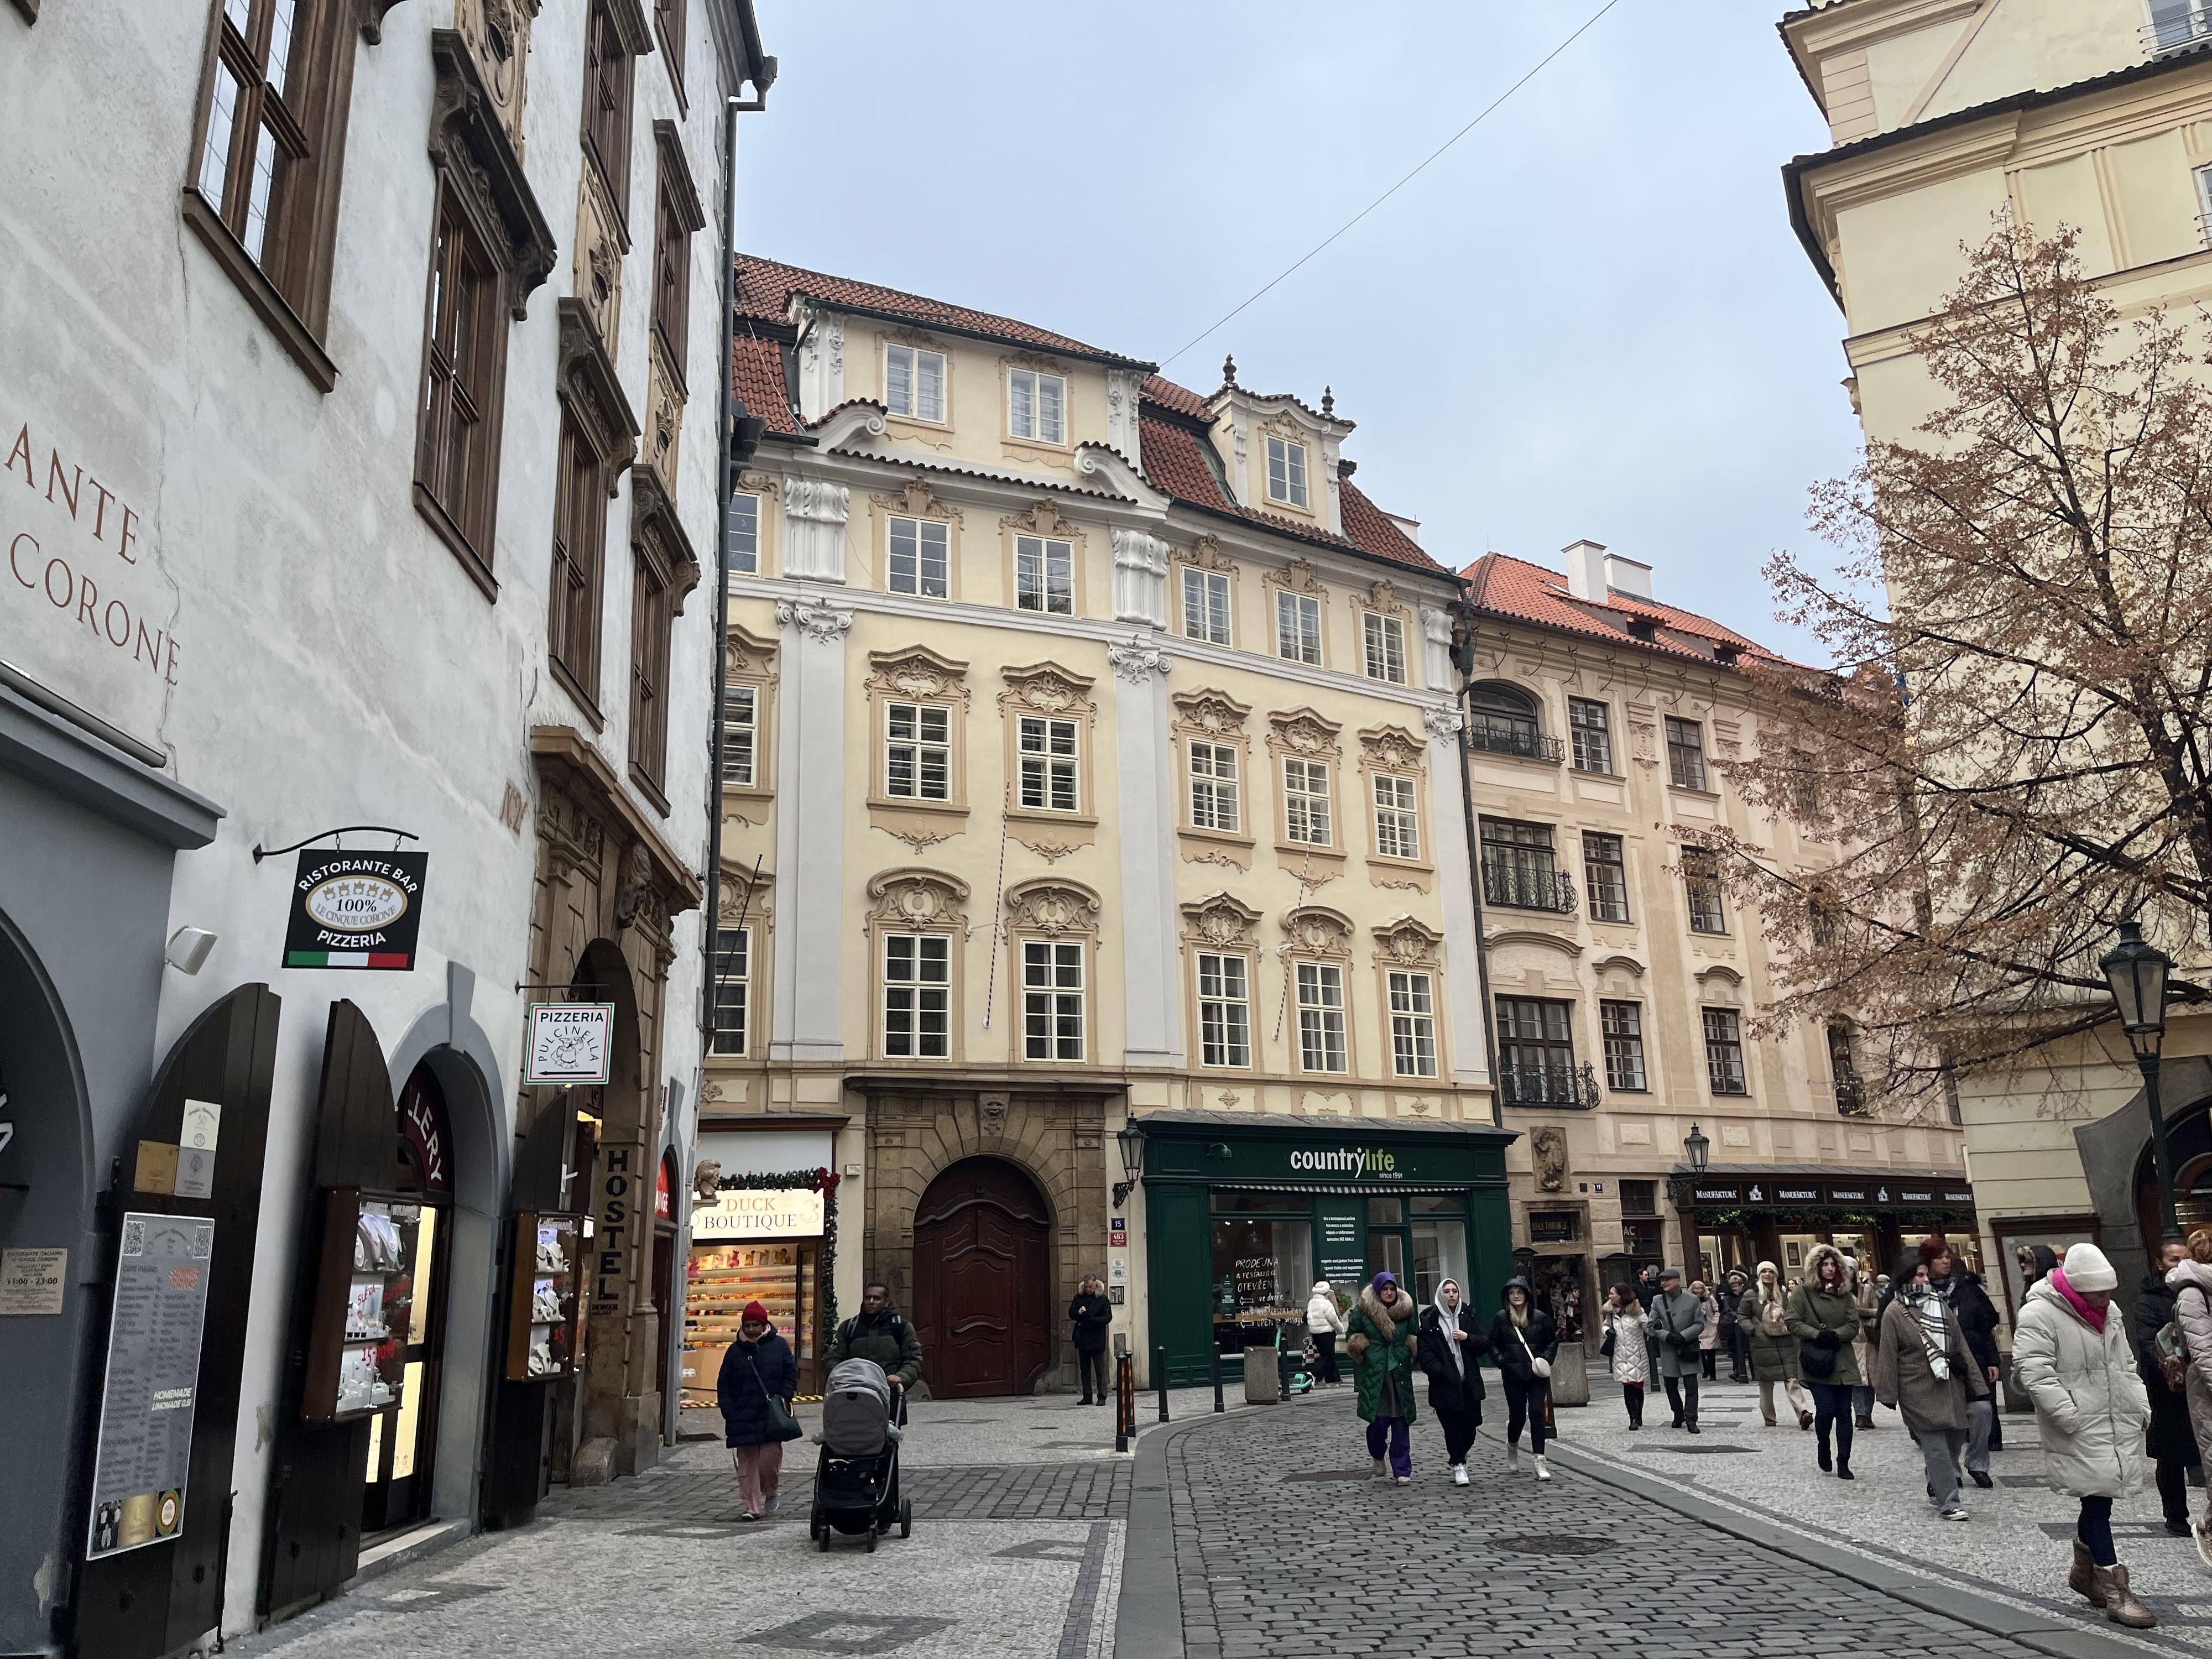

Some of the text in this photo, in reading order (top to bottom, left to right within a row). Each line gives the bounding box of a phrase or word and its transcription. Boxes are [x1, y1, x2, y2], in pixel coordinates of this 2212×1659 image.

[4, 422, 139, 565] ANTE
[10, 533, 180, 686] CORONE
[298, 859, 418, 894] RISTORANTE BAR
[336, 899, 377, 912] 100%
[315, 902, 397, 927] LE CINQUE CORONE
[317, 929, 387, 948] PIZZERIA
[540, 1013, 604, 1022] PIZZERIA
[538, 1026, 599, 1062] PULCINELLA
[1695, 1190, 1737, 1198] MANUFAKTURA
[1779, 1190, 1817, 1199] MANUFAKTURA
[1832, 1191, 1865, 1199] MANUFAKTURA
[726, 1198, 776, 1212] DUCK
[597, 1150, 629, 1300] HOSTEL
[704, 1214, 797, 1230] BOUTIQUE
[1235, 1257, 1279, 1268] PRODEJNA
[1242, 1268, 1277, 1279] restaurace
[1256, 1318, 1274, 1327] OPEN
[153, 1387, 192, 1401] HOMEMADE
[151, 1400, 182, 1411] LIMONADE
